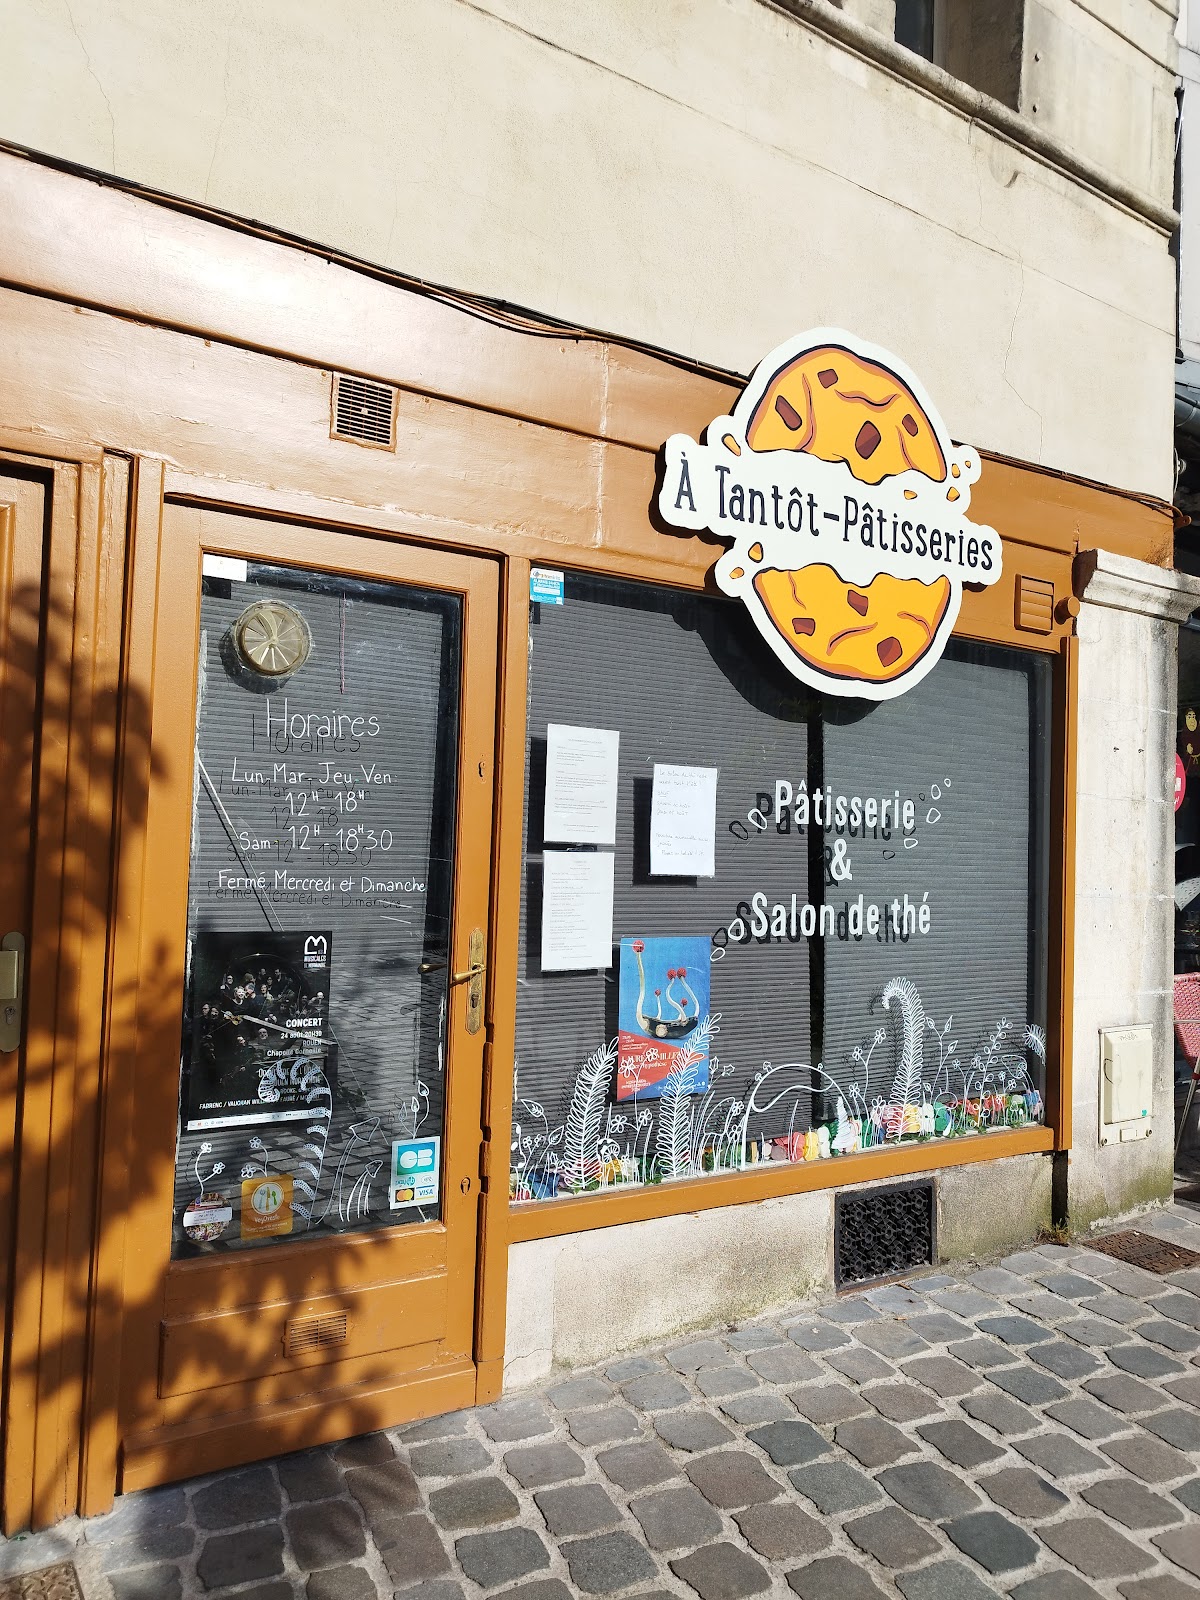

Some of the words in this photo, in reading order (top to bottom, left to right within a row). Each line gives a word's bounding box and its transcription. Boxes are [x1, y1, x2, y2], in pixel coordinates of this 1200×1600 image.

[674, 452, 697, 512] À
[715, 465, 993, 570] Tantôt-Pâtisseries
[267, 698, 380, 738] Horaires
[775, 779, 916, 830] Pâtisserie
[218, 868, 266, 890] Fermé
[274, 869, 335, 892] Mercredi
[340, 876, 356, 891] et
[361, 876, 426, 893] Dimanche
[831, 838, 853, 881] &
[751, 892, 835, 937] Salon
[849, 894, 880, 936] de
[891, 891, 931, 934] thé
[286, 1018, 323, 1028] CONCERT
